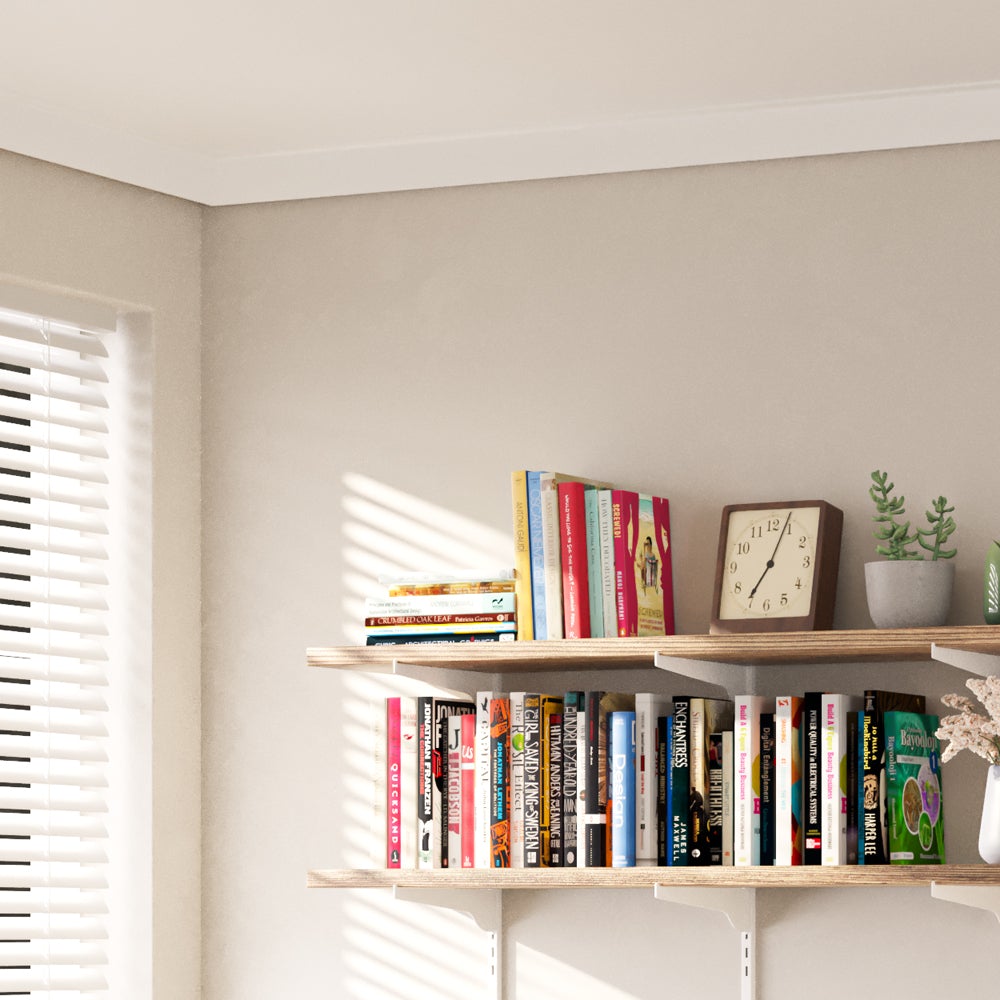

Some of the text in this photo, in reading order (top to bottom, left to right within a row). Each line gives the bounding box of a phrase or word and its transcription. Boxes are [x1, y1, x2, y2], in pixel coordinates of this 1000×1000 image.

[613, 504, 621, 538] SCREWED!
[751, 526, 762, 538] 11
[767, 519, 779, 532] 12
[787, 523, 792, 534] 1
[737, 542, 750, 555] 10
[799, 536, 806, 548] 2
[730, 562, 737, 573] 9
[803, 556, 810, 568] 3
[734, 582, 742, 594] 8
[795, 577, 802, 589] 4
[763, 599, 770, 611] 6
[780, 594, 788, 606] 5
[378, 617, 416, 625] CRUMBLED
[433, 615, 452, 623] LEAF
[809, 710, 817, 730] POWER
[550, 725, 561, 762] HITMAN
[675, 702, 688, 768] ENCHANTRESS
[762, 727, 770, 751] Digital
[808, 731, 817, 756] QUALITY
[481, 720, 489, 785] CAPITAL
[525, 742, 538, 774] SAVED
[550, 763, 561, 797] ANDERS
[614, 754, 626, 828] Design
[762, 755, 770, 803] Entanglement
[809, 763, 817, 798] ELECTRICAL
[525, 782, 538, 806] KING
[809, 798, 817, 824] SYSTEMS
[525, 810, 538, 850] SWEDEN
[864, 813, 877, 855] HARPER LEE
